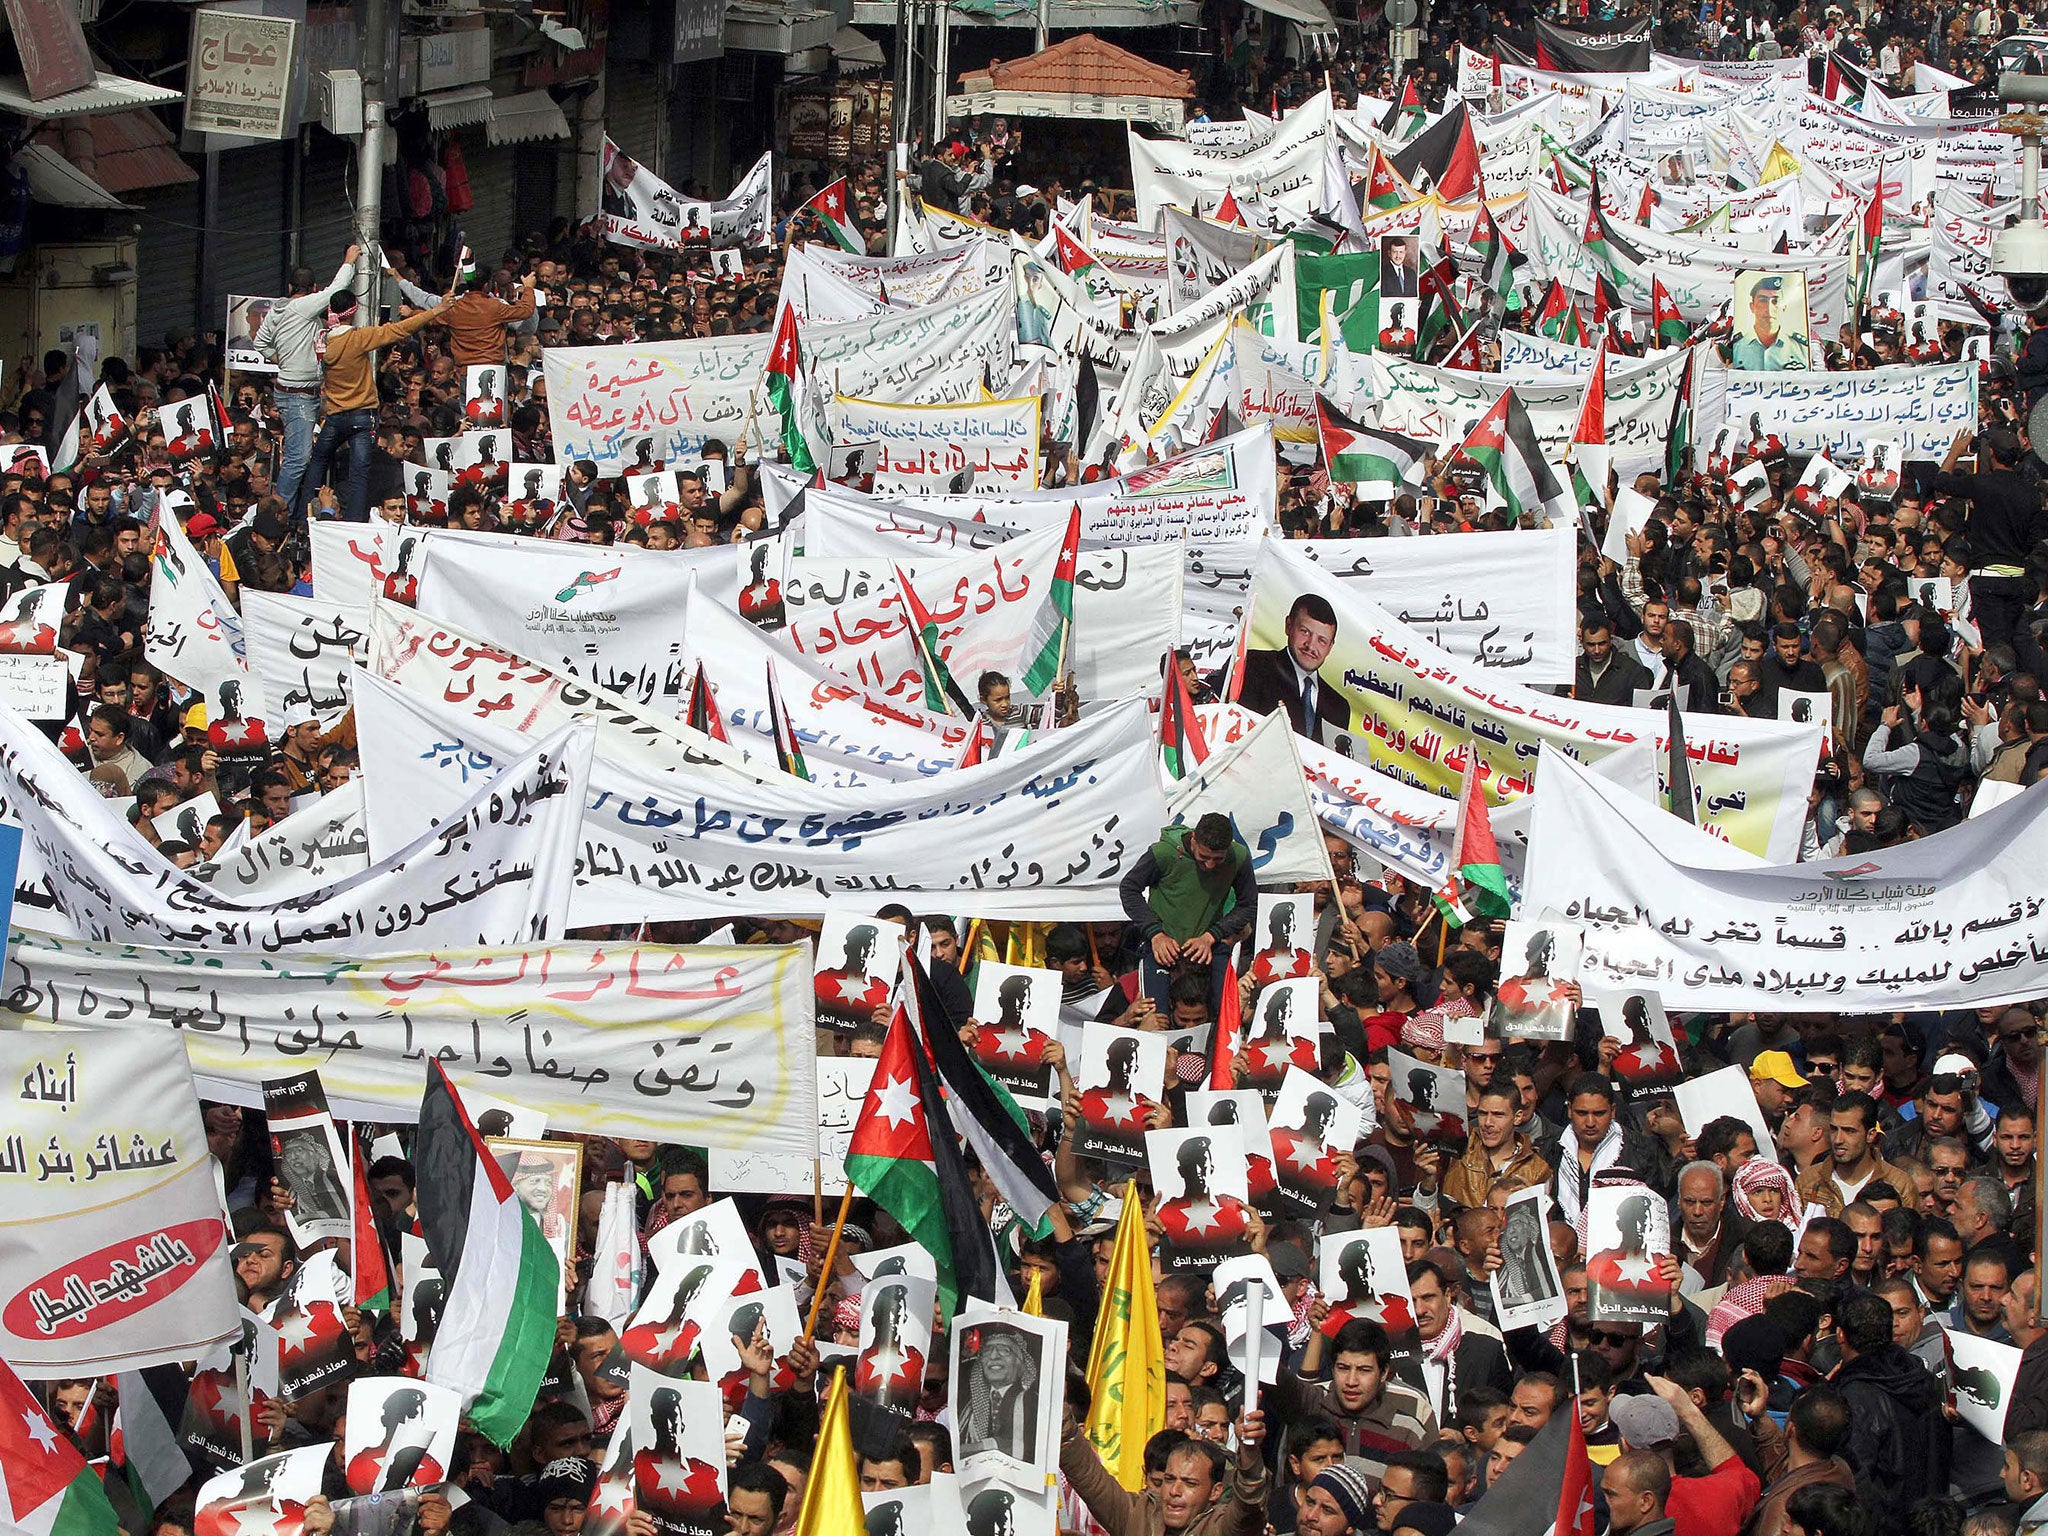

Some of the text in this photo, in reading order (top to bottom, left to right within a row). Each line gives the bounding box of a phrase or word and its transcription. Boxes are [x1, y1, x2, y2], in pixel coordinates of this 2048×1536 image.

[201, 31, 278, 75] عجاج
[193, 79, 283, 101] للشريط الإسلامي
[1192, 148, 1228, 160] 2475
[588, 356, 665, 399] عشيرة
[1892, 374, 1926, 395] نايف
[1932, 366, 1972, 397] الشيخ
[1792, 406, 1825, 423] بحق
[1937, 400, 1975, 423] الذي
[1106, 493, 1247, 521] مجلس عشائر مدينة اربد ومنهم
[929, 555, 1031, 641] نادي
[1343, 668, 1510, 746] خلف قائدهم العظيم
[1361, 712, 1444, 762] الله ورعاه
[1462, 685, 1580, 731] الشاحنات
[1685, 735, 1740, 767] نقابة
[1565, 895, 1652, 933] الجباه
[1660, 915, 1692, 938] له
[1961, 896, 2046, 939] لأقسم
[262, 908, 366, 953] العمل
[1699, 920, 1762, 945] تخر
[1775, 915, 1847, 950] قسماً
[546, 947, 745, 1002] عشائر
[1683, 963, 1744, 988] مدى
[1752, 966, 1847, 997] وللبلاد
[1855, 959, 1953, 992] للمليك
[274, 1004, 364, 1064] خلف
[816, 1014, 836, 1027] الحق
[1505, 1021, 1524, 1033] الحق
[1524, 1022, 1547, 1035] شهيد
[20, 1051, 76, 1113] أبناء
[999, 1077, 1039, 1092] معاذ شهيد
[1631, 1087, 1649, 1099] الحق
[37, 1133, 178, 1183] عشائر بئر
[1083, 1139, 1144, 1159] معاذ شهيد الحق
[1298, 1195, 1318, 1210] معاذ
[1172, 1255, 1218, 1268] شهيد الحق
[31, 1233, 195, 1333] بالشهيد البطل
[1599, 1302, 1670, 1317] معاذ شهيد الحق
[282, 1358, 348, 1397] معاذ شهيد الحق
[188, 1432, 228, 1458] شهيد الحق
[664, 1520, 688, 1535] شهيد
